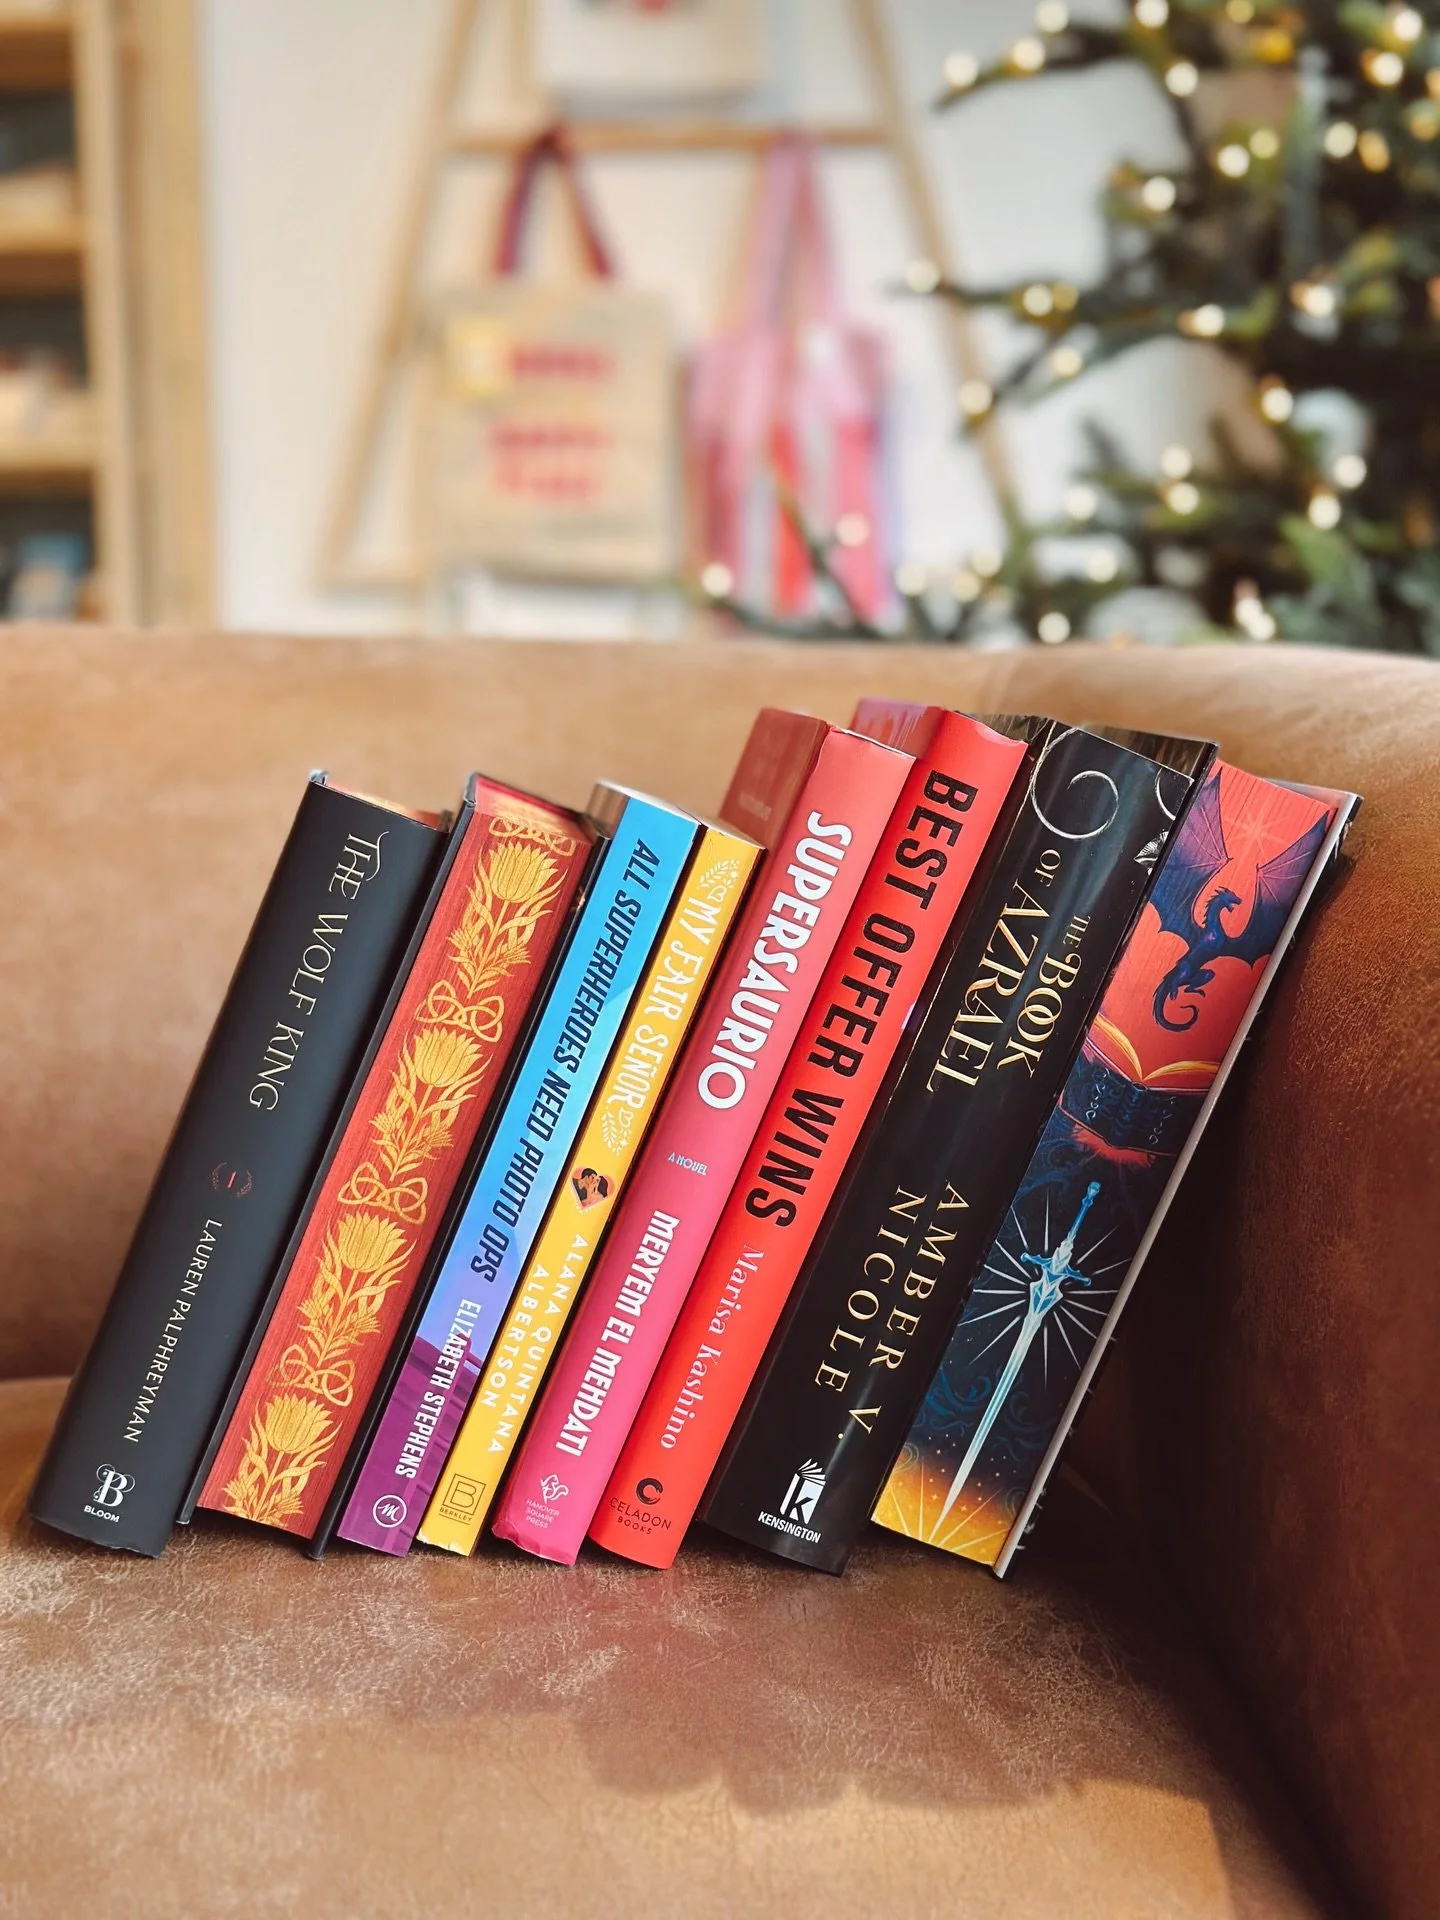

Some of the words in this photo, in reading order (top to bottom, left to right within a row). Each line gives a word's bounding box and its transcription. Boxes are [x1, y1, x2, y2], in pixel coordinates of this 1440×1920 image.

[328, 831, 390, 900] THE
[623, 839, 661, 892] ALL
[884, 769, 979, 911] BEST
[1034, 848, 1062, 888] OF
[288, 914, 349, 1016] WOLF
[678, 897, 722, 947] MY
[697, 810, 855, 1111] SUPERSAURIO
[1062, 914, 1091, 950] THE
[552, 892, 643, 1075] SUPERHEROES
[643, 940, 704, 1022] FAIR
[806, 911, 916, 1080] OFFER
[926, 879, 1051, 1094] AZRAEL
[996, 951, 1083, 1079] BOOK
[249, 1021, 305, 1111] KING
[522, 1067, 573, 1143] NEED
[606, 1024, 669, 1110] SEÑOR
[492, 1137, 545, 1229] PHOTO
[668, 1152, 677, 1163] A
[676, 1154, 710, 1177] NOVEL
[744, 1087, 846, 1228] WINS
[183, 1218, 223, 1297] LAUREN
[470, 1223, 510, 1284] OPS
[544, 1233, 590, 1316] ALANA
[614, 1209, 681, 1318] MERYEM
[708, 1243, 766, 1336] Marisa
[814, 1184, 928, 1394] NICOLE
[869, 1180, 970, 1371] AMBER
[123, 1299, 192, 1443] PALPHREYMAN
[429, 1298, 483, 1390] ELIZABETH
[480, 1263, 551, 1409] ALBERTSON
[600, 1315, 636, 1345] EL
[487, 1324, 553, 1453] QUINTANA
[554, 1346, 624, 1458] MEHDATI
[660, 1343, 724, 1450] Kashino
[837, 1404, 883, 1440] V.
[394, 1391, 446, 1480] STEPHENS
[84, 1505, 120, 1523] BLOOM
[438, 1506, 474, 1523] BERKLEY
[525, 1514, 549, 1530] PRESS
[526, 1498, 561, 1517] HANOVER
[526, 1507, 555, 1523] SQUARE
[609, 1496, 672, 1531] CELADON
[616, 1515, 653, 1535] BOOKS
[757, 1511, 822, 1544] KENSINGTON
